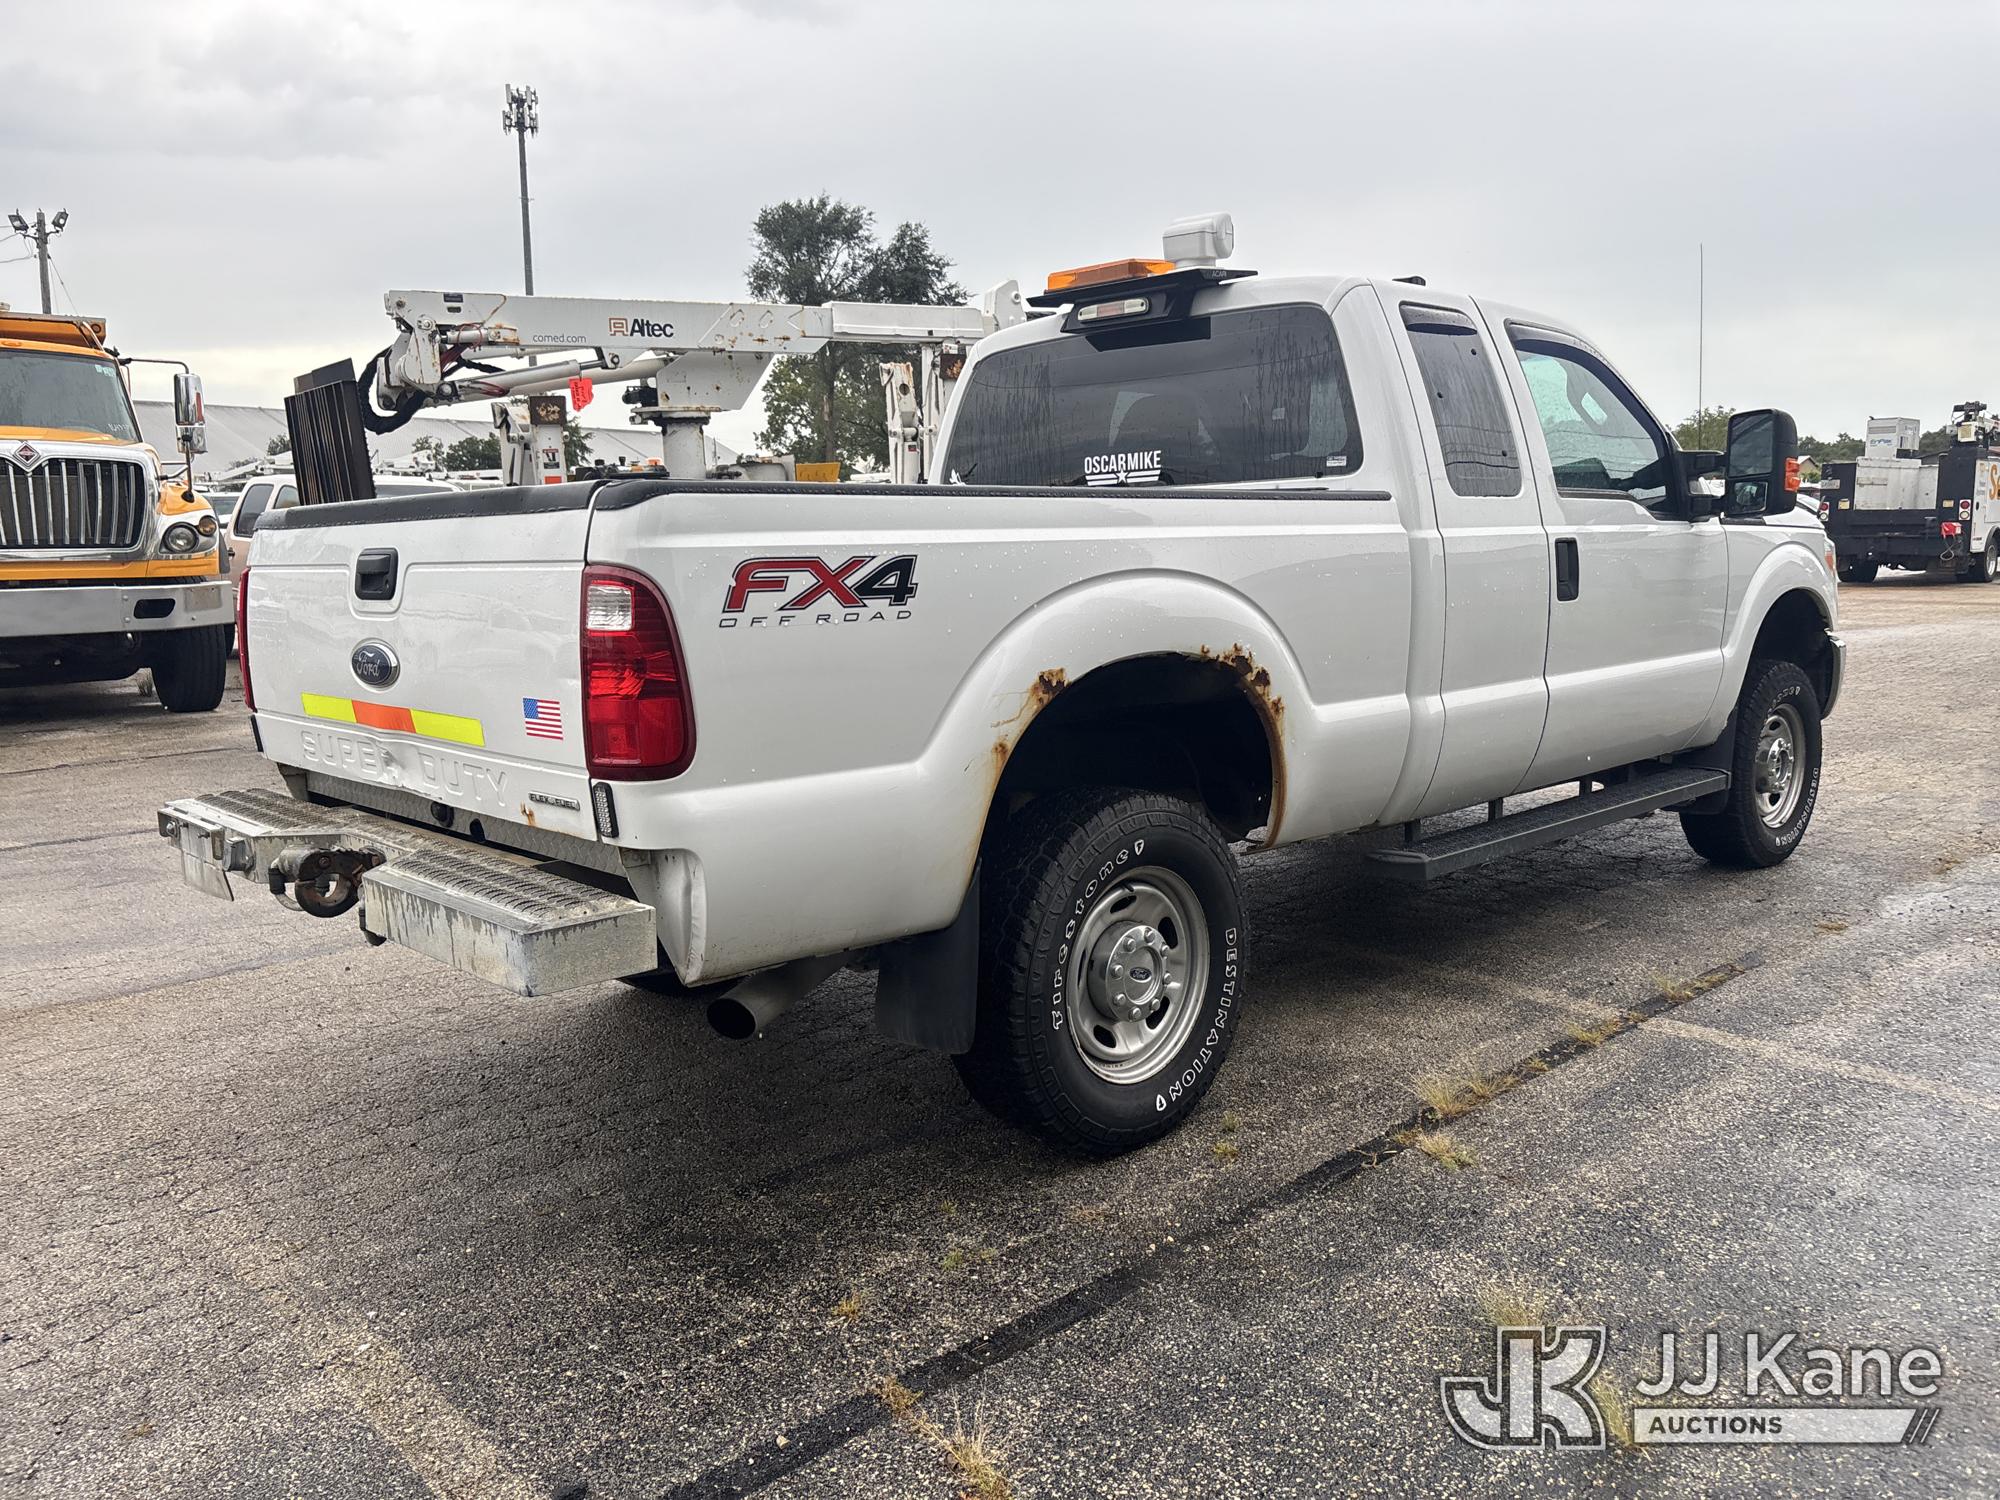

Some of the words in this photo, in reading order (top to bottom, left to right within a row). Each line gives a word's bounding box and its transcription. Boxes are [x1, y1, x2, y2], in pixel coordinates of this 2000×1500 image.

[532, 333, 587, 343] comed.com
[630, 318, 674, 337] Altec
[1084, 450, 1161, 474] OSCARMIKE
[722, 554, 918, 613] FX4
[719, 615, 796, 628] OFF
[816, 611, 912, 624] ROAD
[418, 751, 507, 808] DUTY
[1169, 927, 1237, 1101] DESTINATION
